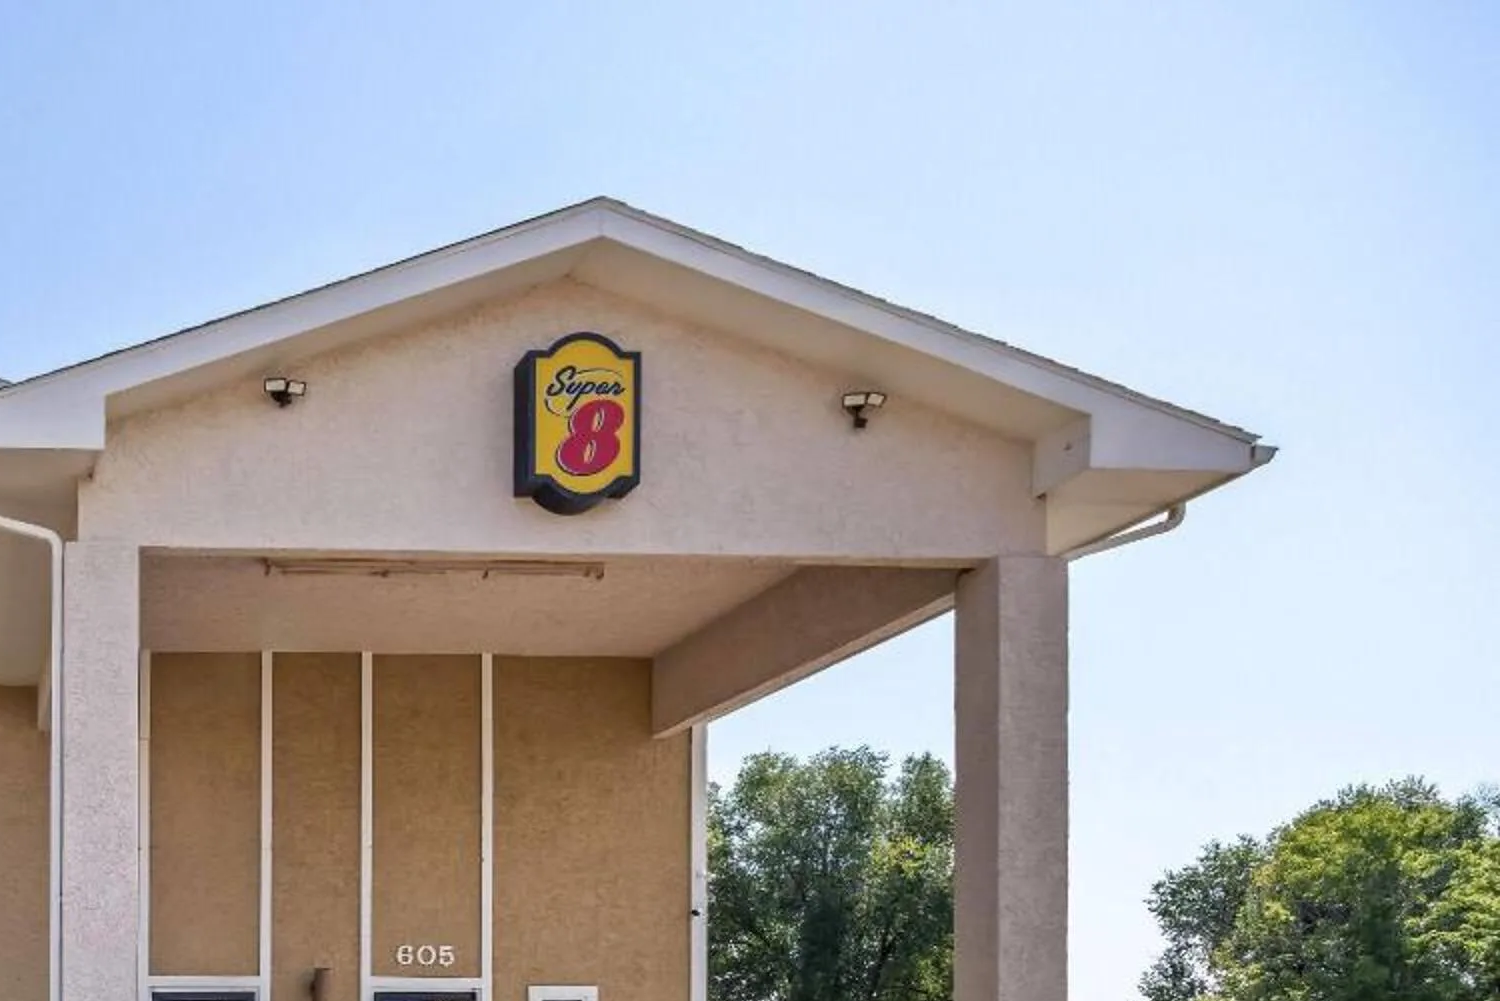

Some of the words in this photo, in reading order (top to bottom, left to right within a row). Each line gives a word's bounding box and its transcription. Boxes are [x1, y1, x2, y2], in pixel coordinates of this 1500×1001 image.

[543, 365, 627, 416] Super
[555, 399, 625, 476] 8
[396, 945, 455, 966] 605
